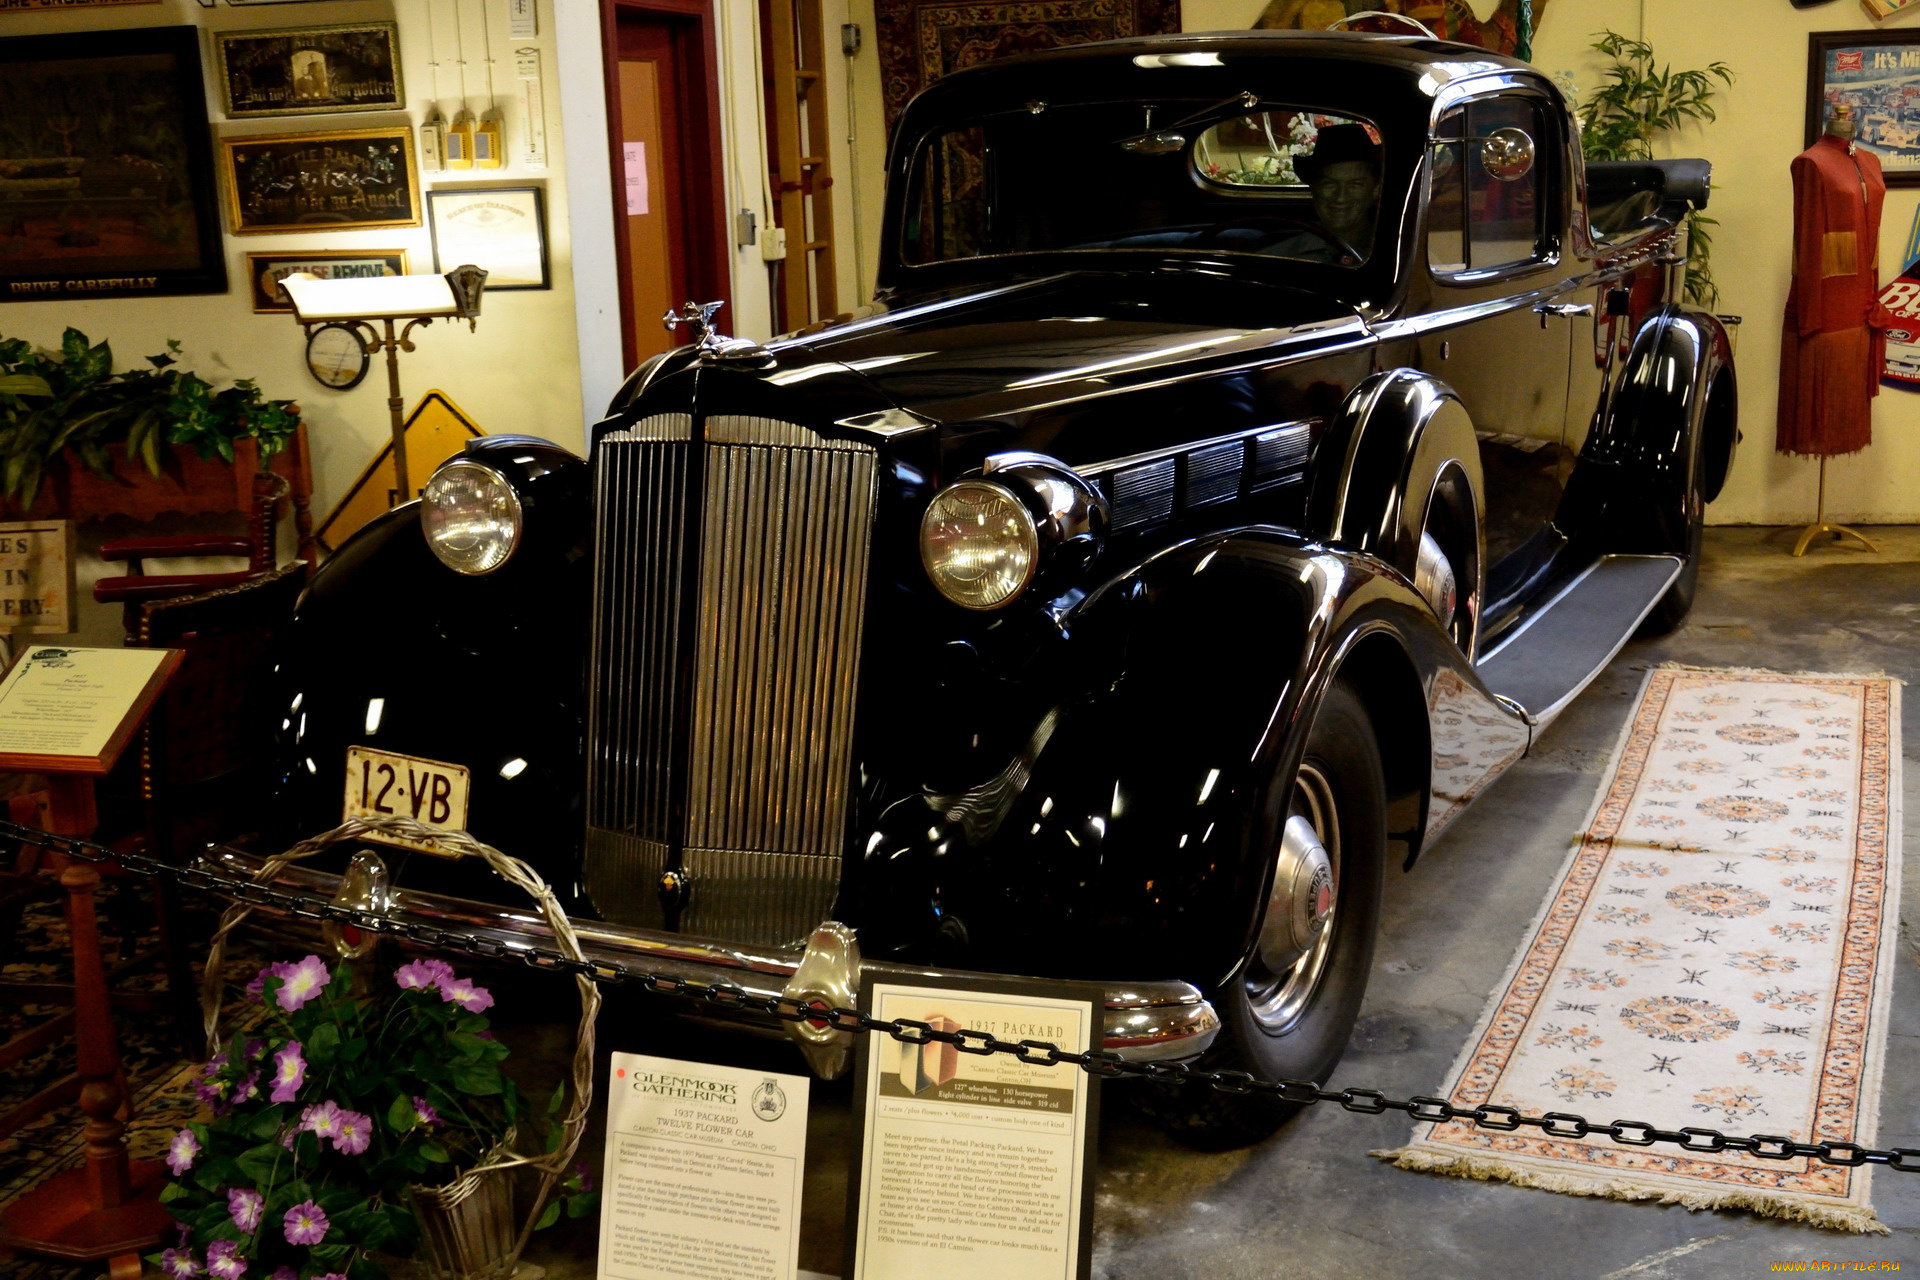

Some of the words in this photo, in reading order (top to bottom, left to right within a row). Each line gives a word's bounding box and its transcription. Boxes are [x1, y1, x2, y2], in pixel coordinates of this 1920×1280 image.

[1875, 51, 1897, 69] It's
[325, 147, 372, 174] RALPH
[332, 263, 384, 279] REMOVE
[10, 281, 60, 293] DRIVE
[65, 277, 157, 291] CAREFULLY
[5, 569, 29, 585] IN
[969, 1019, 995, 1032] 1937
[1003, 1021, 1063, 1038] PACKARD
[1023, 1062, 1030, 1070] by
[632, 1081, 736, 1104] GATHERING
[633, 1071, 737, 1094] GLENMOOR
[968, 1085, 997, 1093] wheelbase
[1014, 1089, 1048, 1100] horsepower
[938, 1090, 954, 1100] Eight
[955, 1092, 979, 1102] cylinder
[988, 1095, 1000, 1103] line
[1016, 1098, 1032, 1106] valve
[674, 1108, 694, 1119] 1937
[696, 1111, 738, 1125] PACKARD
[888, 1104, 902, 1112] seats
[921, 1108, 943, 1116] flowers
[990, 1114, 1013, 1123] custom
[1013, 1117, 1028, 1126] body
[1050, 1120, 1064, 1128] kind
[656, 1116, 693, 1130] TWELVE
[695, 1122, 732, 1135] FLOWER
[734, 1127, 754, 1138] CAR
[883, 1140, 899, 1148] been
[900, 1142, 927, 1152] together
[928, 1145, 944, 1153] since
[946, 1147, 970, 1157] infancy
[996, 1152, 1019, 1160] remain
[1020, 1155, 1048, 1165] together
[913, 1135, 938, 1145] partner,
[969, 1141, 995, 1151] Packing
[996, 1143, 1024, 1152] Packard.
[895, 1160, 907, 1168] me,
[922, 1162, 933, 1170] got
[953, 1165, 992, 1177] handsomely
[994, 1169, 1017, 1178] crafted
[1018, 1172, 1039, 1180] flower
[919, 1153, 943, 1163] parted.
[944, 1155, 959, 1163] He's
[966, 1158, 976, 1166] big
[977, 1159, 998, 1169] strong
[999, 1161, 1019, 1171] Super
[1019, 1163, 1026, 1171] 8,
[1027, 1164, 1057, 1173] stretched
[881, 1166, 925, 1178] configuration
[934, 1173, 951, 1181] carry
[974, 1176, 998, 1184] flowers
[999, 1179, 1029, 1189] honoring
[881, 1175, 912, 1184] bereaved.
[960, 1183, 976, 1191] head
[997, 1187, 1032, 1198] procession
[1033, 1191, 1049, 1199] with
[880, 1183, 911, 1194] following
[912, 1187, 935, 1197] closely
[936, 1189, 960, 1198] behind.
[974, 1193, 990, 1201] have
[991, 1195, 1013, 1205] always
[1015, 1198, 1040, 1206] worked
